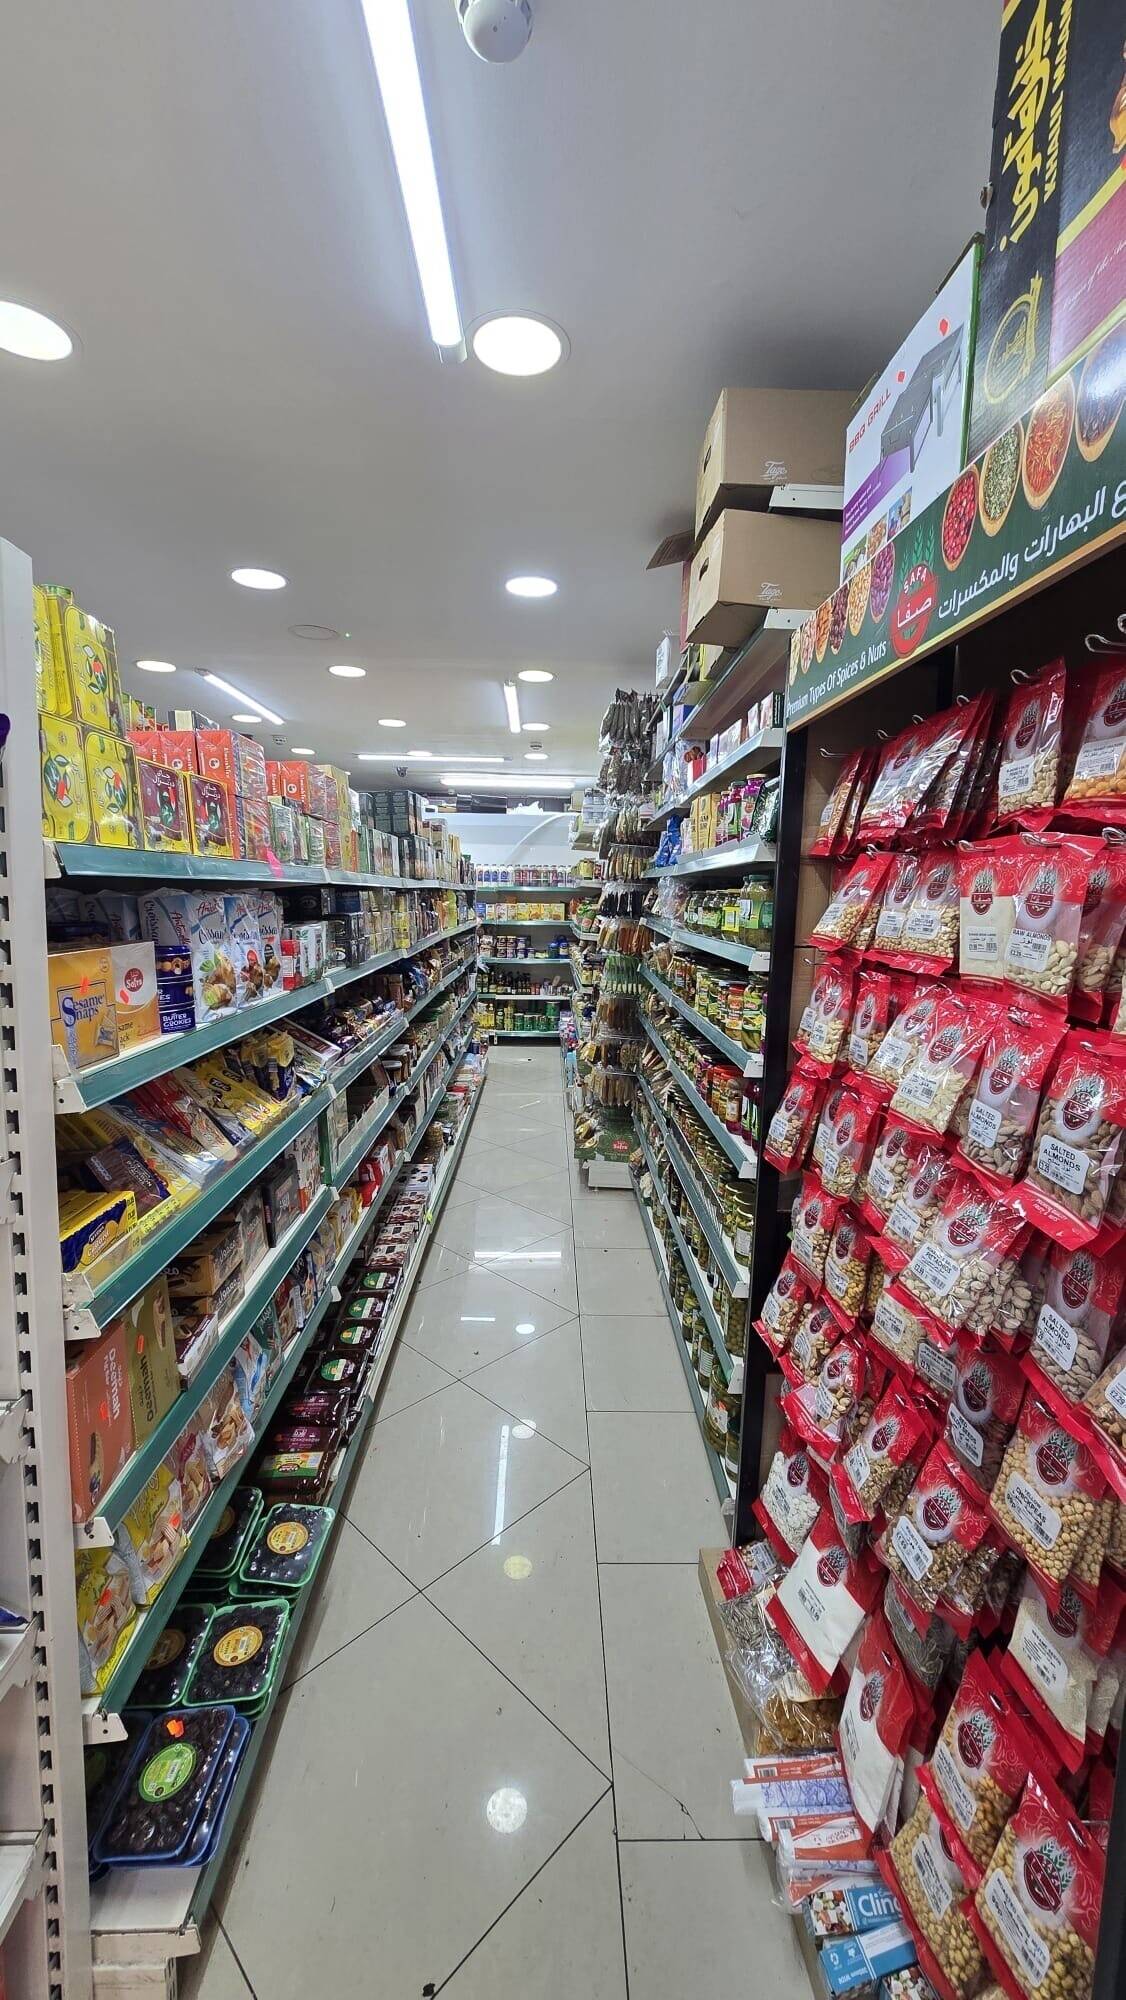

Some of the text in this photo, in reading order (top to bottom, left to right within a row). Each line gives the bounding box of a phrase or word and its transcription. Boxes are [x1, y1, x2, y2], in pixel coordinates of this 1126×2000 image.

[1044, 90, 1064, 203] KHALIL
[848, 388, 891, 454] BBQ GRILL
[1024, 485, 1107, 563] البهارات
[903, 566, 927, 594] SAFA
[938, 552, 1019, 619] والمكسرات
[897, 597, 932, 627] صفا
[786, 693, 809, 717] Premium
[809, 680, 826, 705] Types
[826, 668, 838, 692] Of
[836, 659, 858, 688] Spices
[867, 641, 887, 666] Nuts
[163, 1013, 187, 1022] BUTTER
[163, 1018, 192, 1028] COOKIES
[209, 1077, 231, 1092] TUC
[970, 1112, 997, 1130] ALMONDS
[975, 1106, 995, 1121] SALTED
[1043, 1149, 1081, 1171] ALMONDS
[1050, 1143, 1076, 1161] SALTED
[1041, 1316, 1072, 1351] ALMONDS
[1048, 1314, 1070, 1339] SALTED
[1015, 1486, 1048, 1524] CHICKPEAS
[1023, 1487, 1042, 1509] YELLOW
